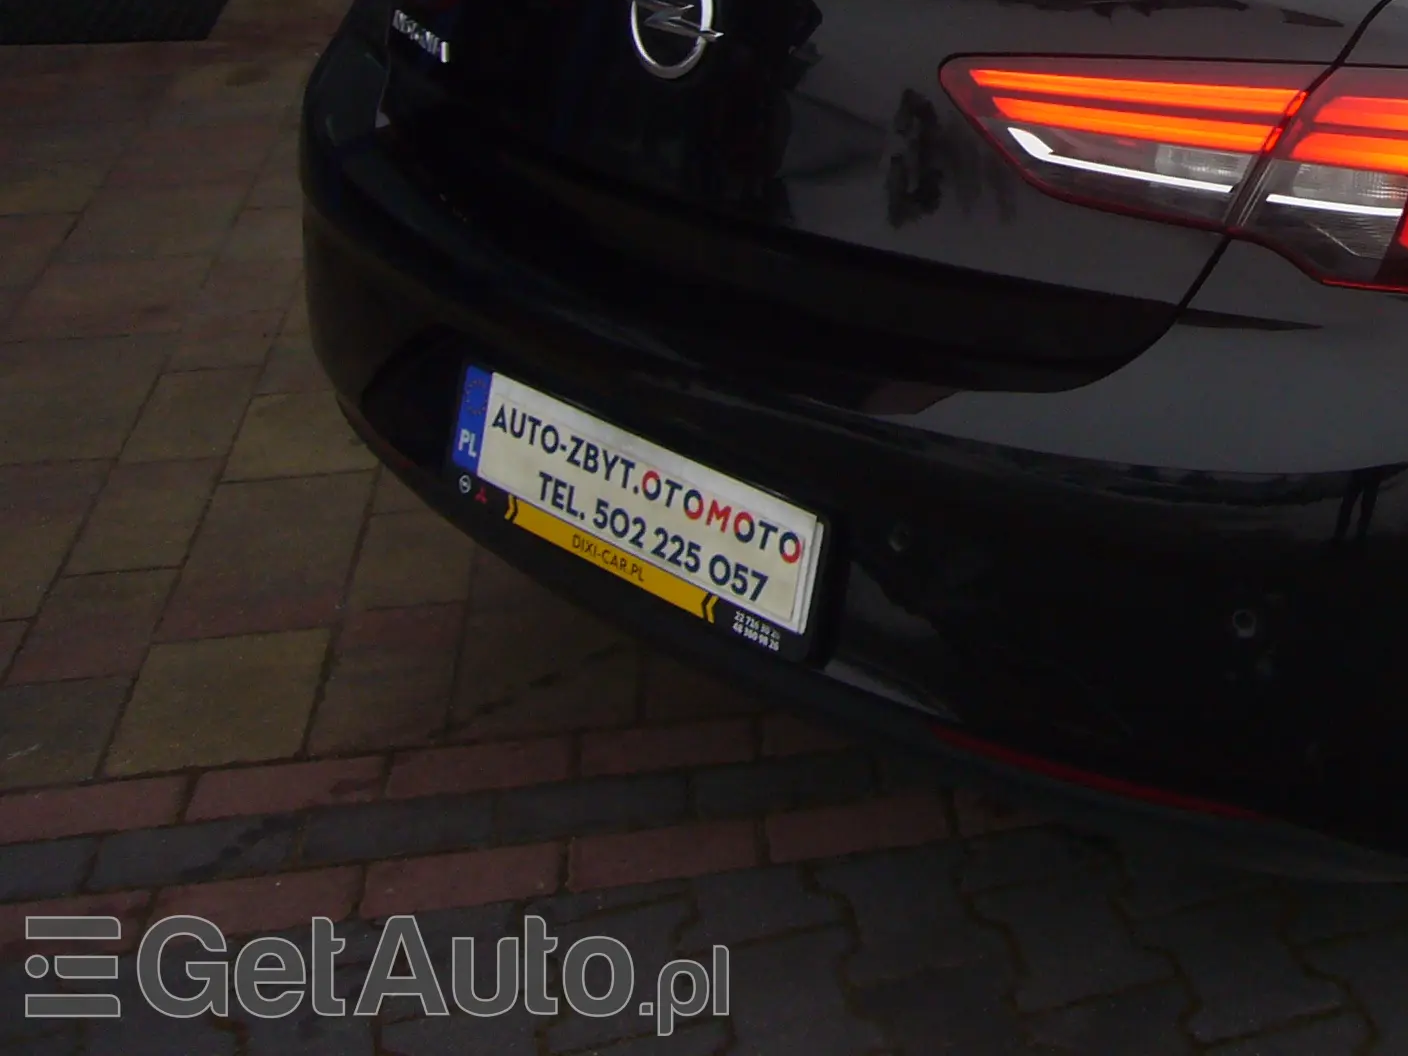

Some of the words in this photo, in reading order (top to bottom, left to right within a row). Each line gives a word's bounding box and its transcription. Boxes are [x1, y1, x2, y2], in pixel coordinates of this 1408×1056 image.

[458, 429, 477, 458] PL
[491, 403, 803, 563] AUTO-ZBYT.OTOMOTO
[538, 470, 586, 521] TEL.
[593, 498, 646, 557] 502
[650, 525, 702, 574] 225
[708, 553, 769, 602] 057
[571, 533, 645, 581] DIXI-CAR.PL
